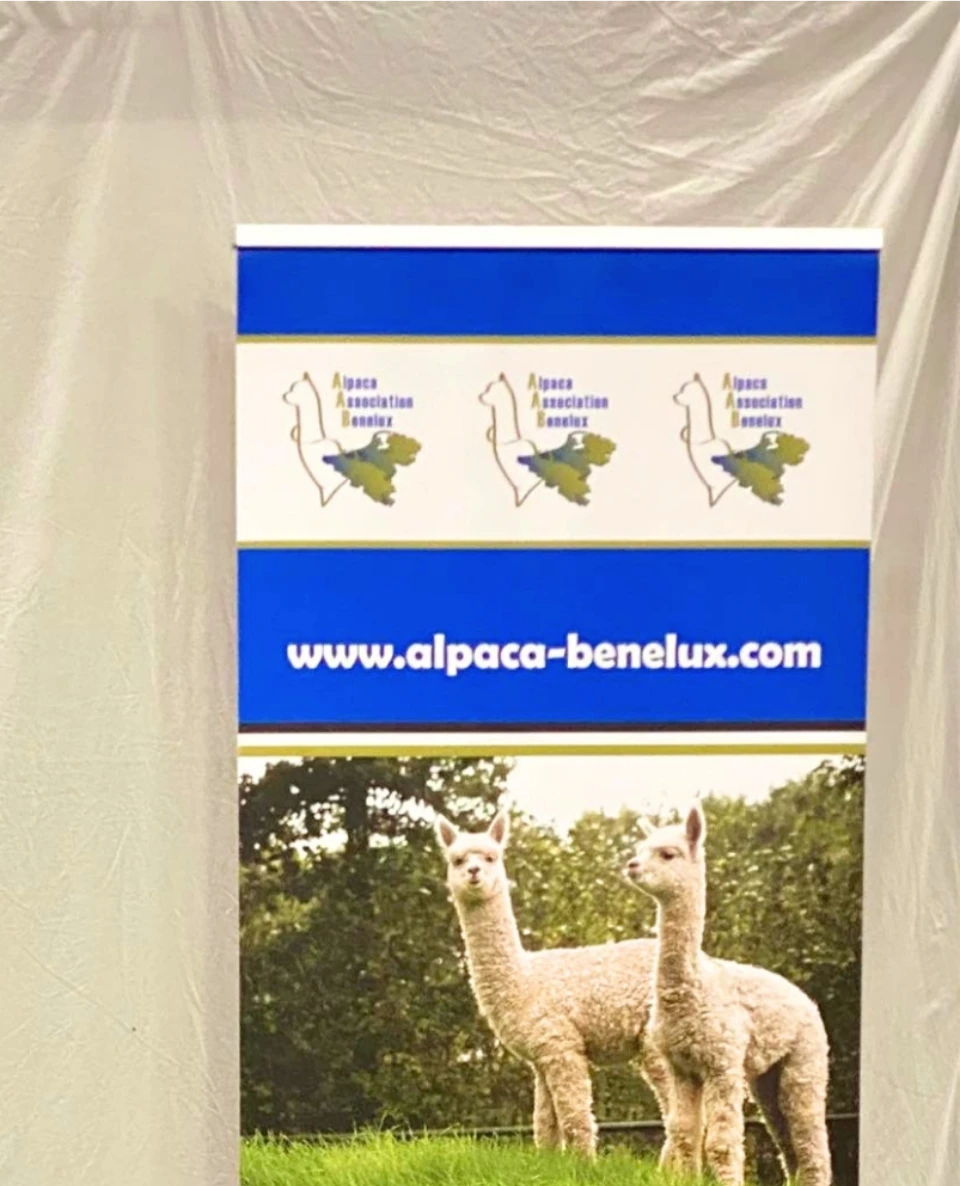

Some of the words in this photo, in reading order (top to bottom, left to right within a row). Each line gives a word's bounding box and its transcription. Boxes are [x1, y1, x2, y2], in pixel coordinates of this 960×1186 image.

[332, 372, 377, 391] Alpaca
[527, 372, 572, 392] Alpaca
[722, 372, 767, 392] Alpaca
[336, 391, 413, 408] Association
[531, 391, 608, 409] Association
[725, 391, 802, 409] Association
[341, 409, 392, 428] Benelux
[537, 410, 588, 428] Benelux
[731, 410, 781, 428] Benelux
[287, 633, 822, 677] www.alpaca-benelux.com
